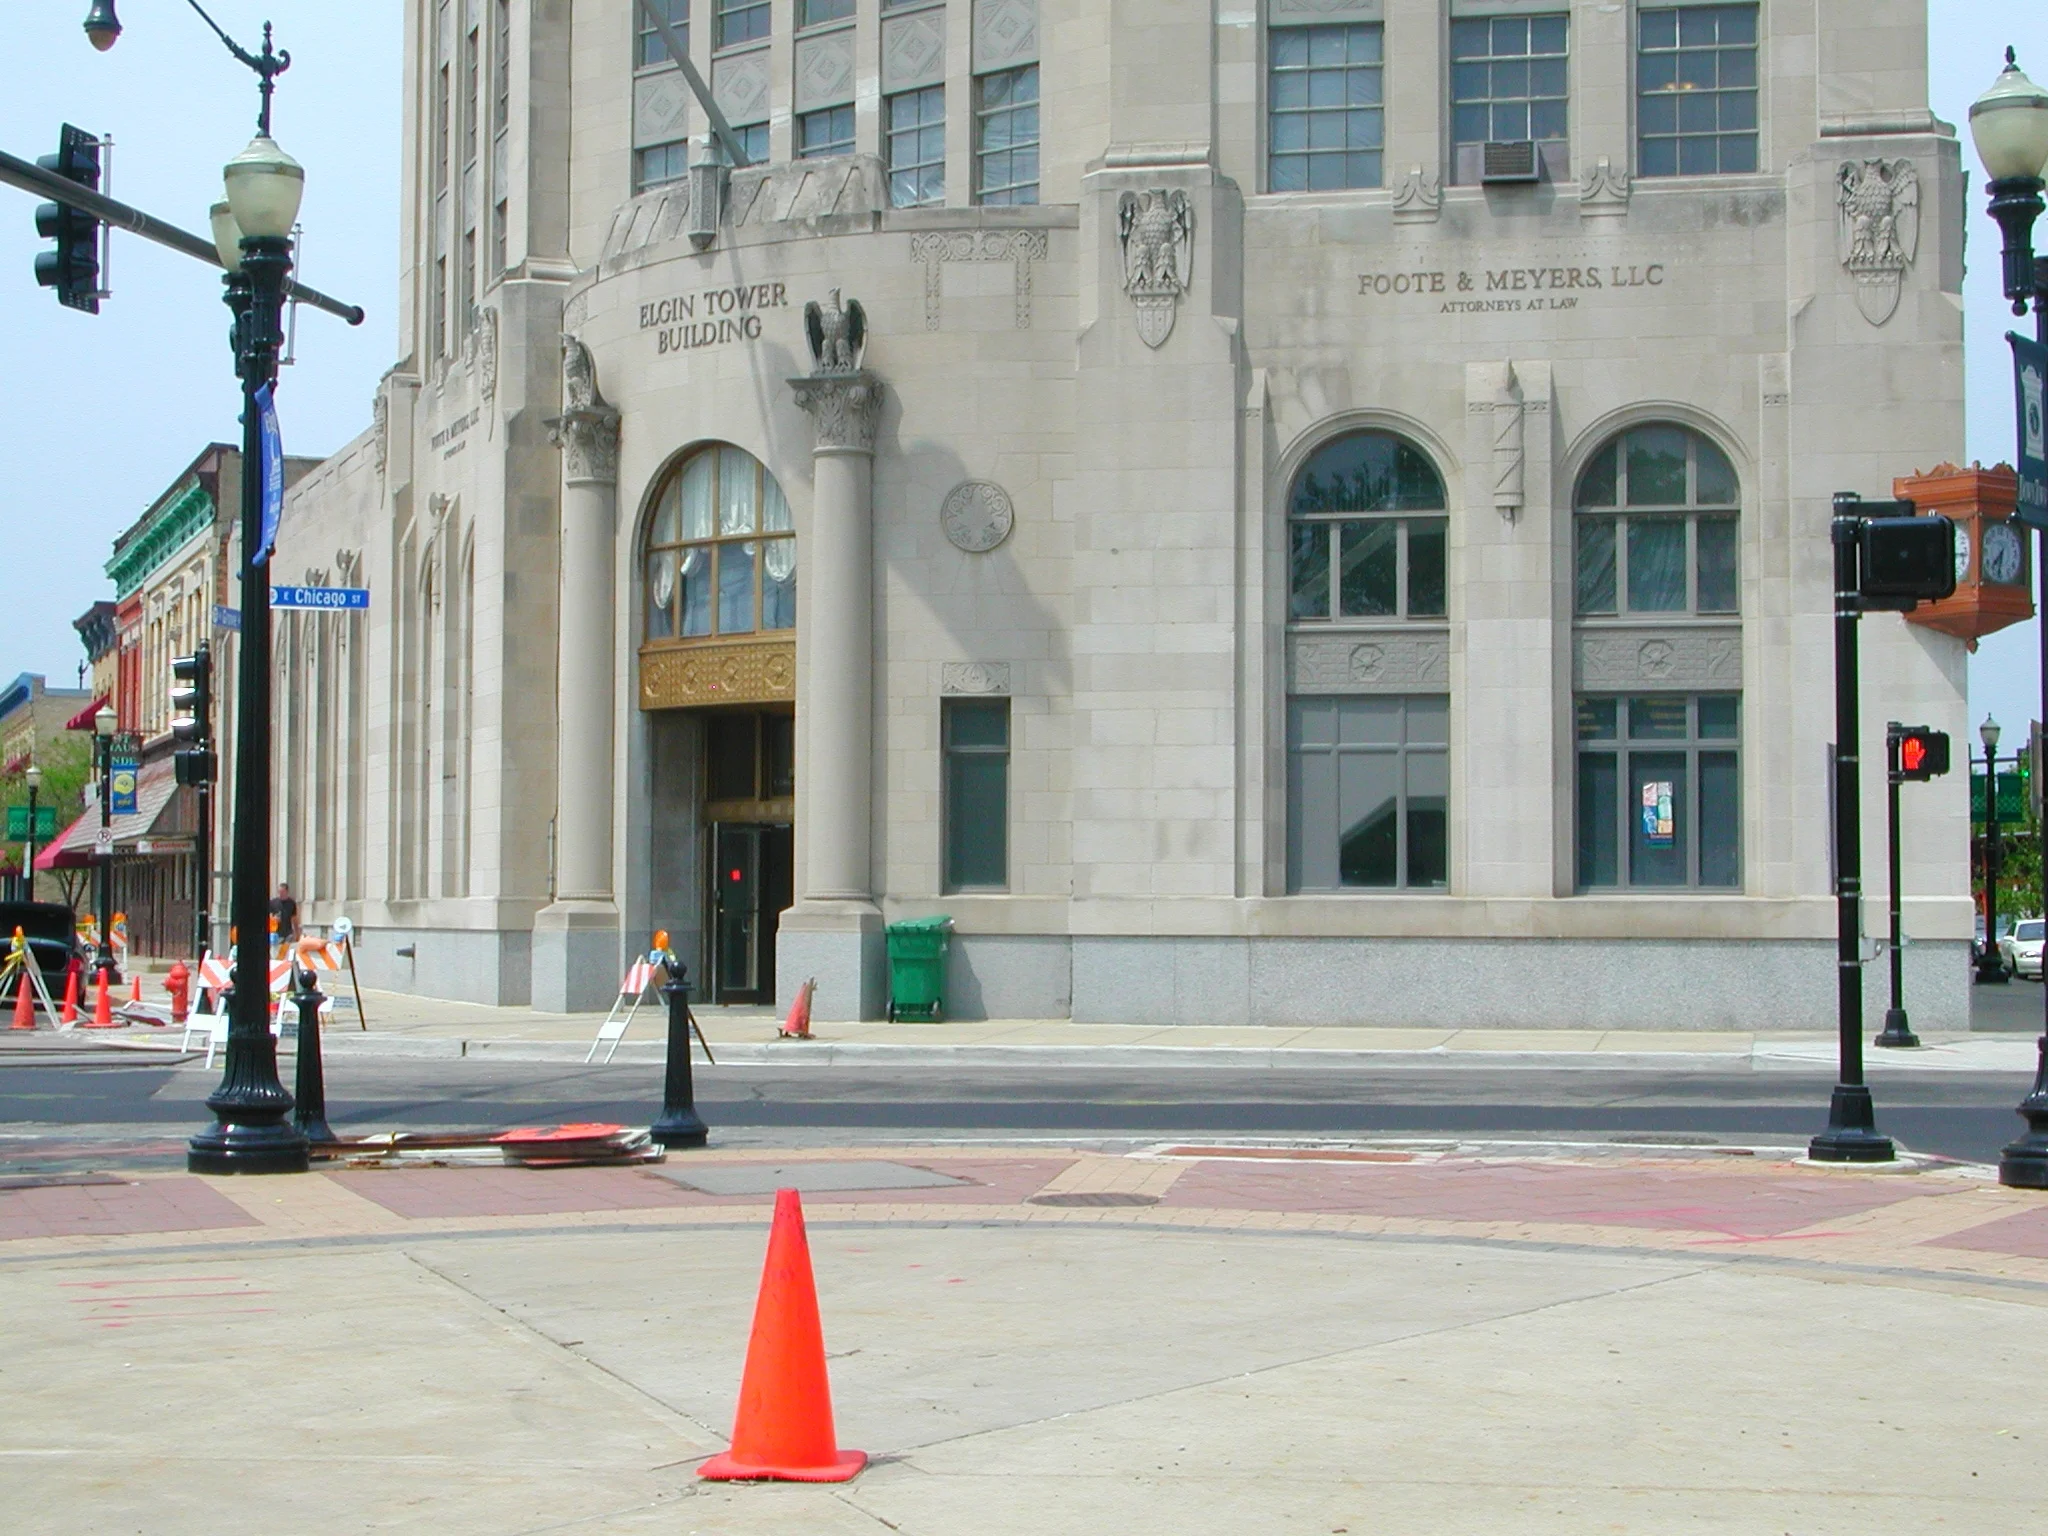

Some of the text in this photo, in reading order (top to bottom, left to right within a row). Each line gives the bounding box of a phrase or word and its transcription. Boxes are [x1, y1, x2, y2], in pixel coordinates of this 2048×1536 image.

[1358, 272, 1446, 295] FOOTE
[1457, 271, 1474, 292] &
[1611, 265, 1665, 287] LLC
[640, 282, 788, 329] ELGIN TOWER
[1440, 297, 1579, 313] ATTORNEYS AT LAW
[658, 315, 762, 355] BUILDING
[283, 589, 361, 607] E Chicago ST
